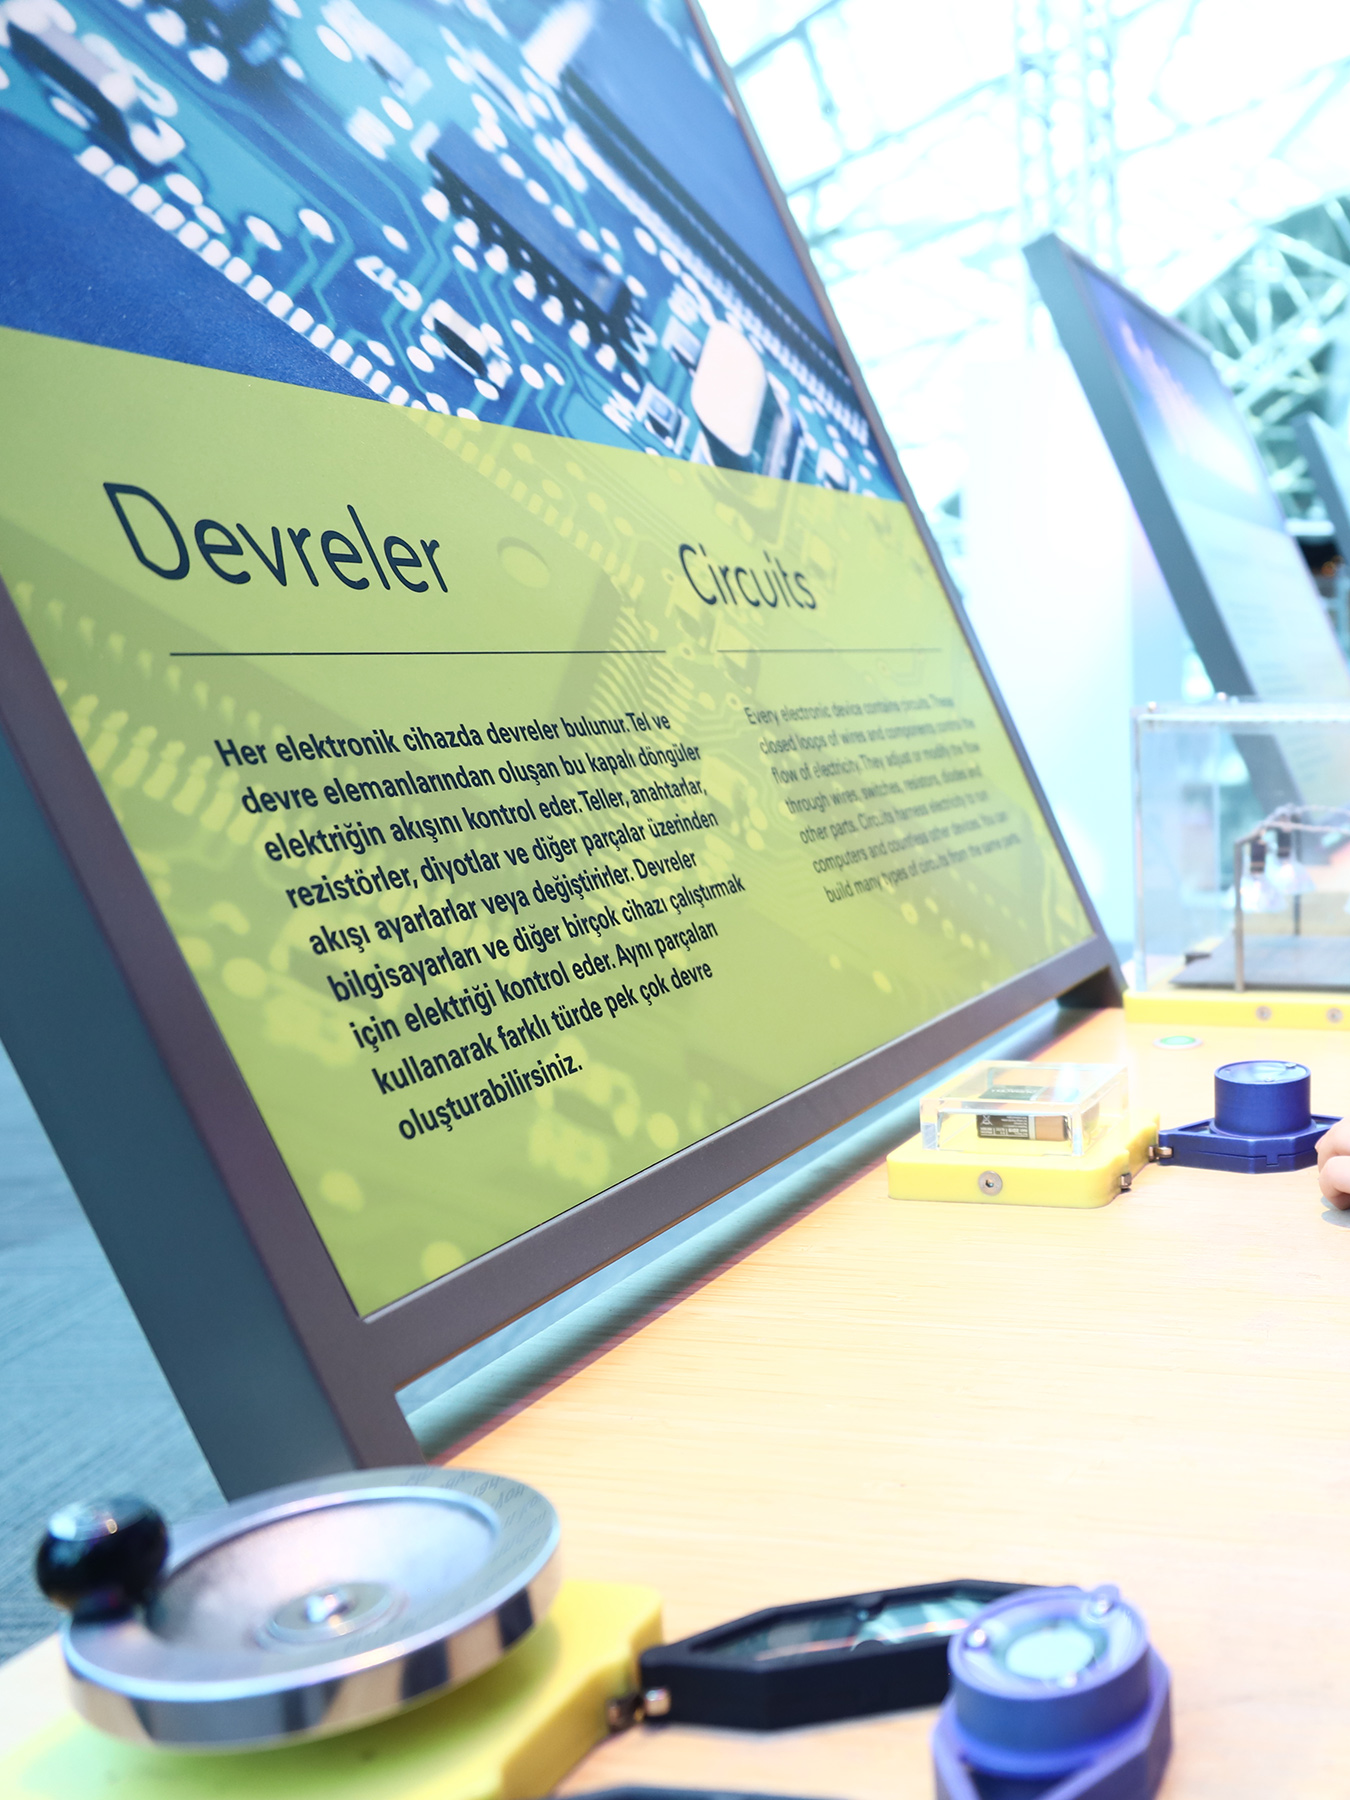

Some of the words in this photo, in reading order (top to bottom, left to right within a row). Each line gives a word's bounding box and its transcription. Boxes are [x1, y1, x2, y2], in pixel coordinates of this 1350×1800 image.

[103, 481, 448, 593] Devreler
[678, 542, 817, 609] Circuits
[213, 738, 268, 767] Her
[275, 728, 401, 763] elektronik
[402, 723, 485, 752] cihazda
[486, 718, 560, 745] devreler
[559, 715, 629, 738] bulunur.
[626, 712, 652, 732] Tel
[651, 715, 671, 730] ve
[744, 707, 779, 726] Every
[759, 735, 795, 755] closed
[796, 733, 828, 752] loops
[827, 729, 839, 746] of
[241, 786, 319, 814] devre
[323, 765, 496, 805] elemanlarından
[498, 760, 561, 786] oluşan
[558, 754, 587, 776] bu
[584, 748, 637, 776] kapalı
[638, 743, 701, 768] döngüler
[771, 766, 798, 784] flow
[800, 762, 811, 781] of
[785, 792, 830, 814] through
[264, 821, 387, 862] elektriğin
[389, 815, 463, 844] akışını
[461, 798, 537, 830] kontrol
[538, 794, 583, 819] eder.
[576, 788, 630, 812] Teller,
[630, 777, 707, 804] anahtarlar,
[800, 825, 829, 844] other
[830, 819, 859, 841] parts.
[285, 865, 418, 909] rezistörler,
[420, 848, 501, 885] diyotlar
[503, 847, 530, 866] ve
[532, 835, 579, 863] diğer
[580, 822, 646, 857] parçalar
[647, 810, 719, 838] üzerinden
[812, 847, 868, 874] computers
[869, 841, 888, 858] and
[823, 881, 855, 903] build
[853, 875, 882, 894] many
[309, 925, 371, 956] akışı
[374, 898, 478, 943] ayarlarlar
[480, 889, 531, 916] veya
[532, 864, 635, 904] değiştirirler.
[632, 850, 697, 879] Devreler
[326, 946, 482, 1002] bilgisayarları
[482, 939, 510, 960] ve
[512, 923, 562, 953] diğer
[561, 905, 621, 939] birçok
[621, 898, 669, 923] cihazı
[669, 874, 746, 915] çalıştırmak
[349, 1015, 401, 1053] için
[404, 982, 497, 1033] elektriği
[494, 960, 571, 1003] kontrol
[572, 952, 617, 980] eder.
[615, 941, 654, 968] Aynı
[653, 922, 719, 959] parçaları
[371, 1032, 499, 1095] kullanarak
[496, 1014, 552, 1051] farklı
[550, 997, 604, 1031] türde
[603, 984, 639, 1019] pek
[639, 973, 671, 1007] çok
[670, 963, 713, 990] devre
[398, 1053, 583, 1140] oluşturabilirsiniz.
